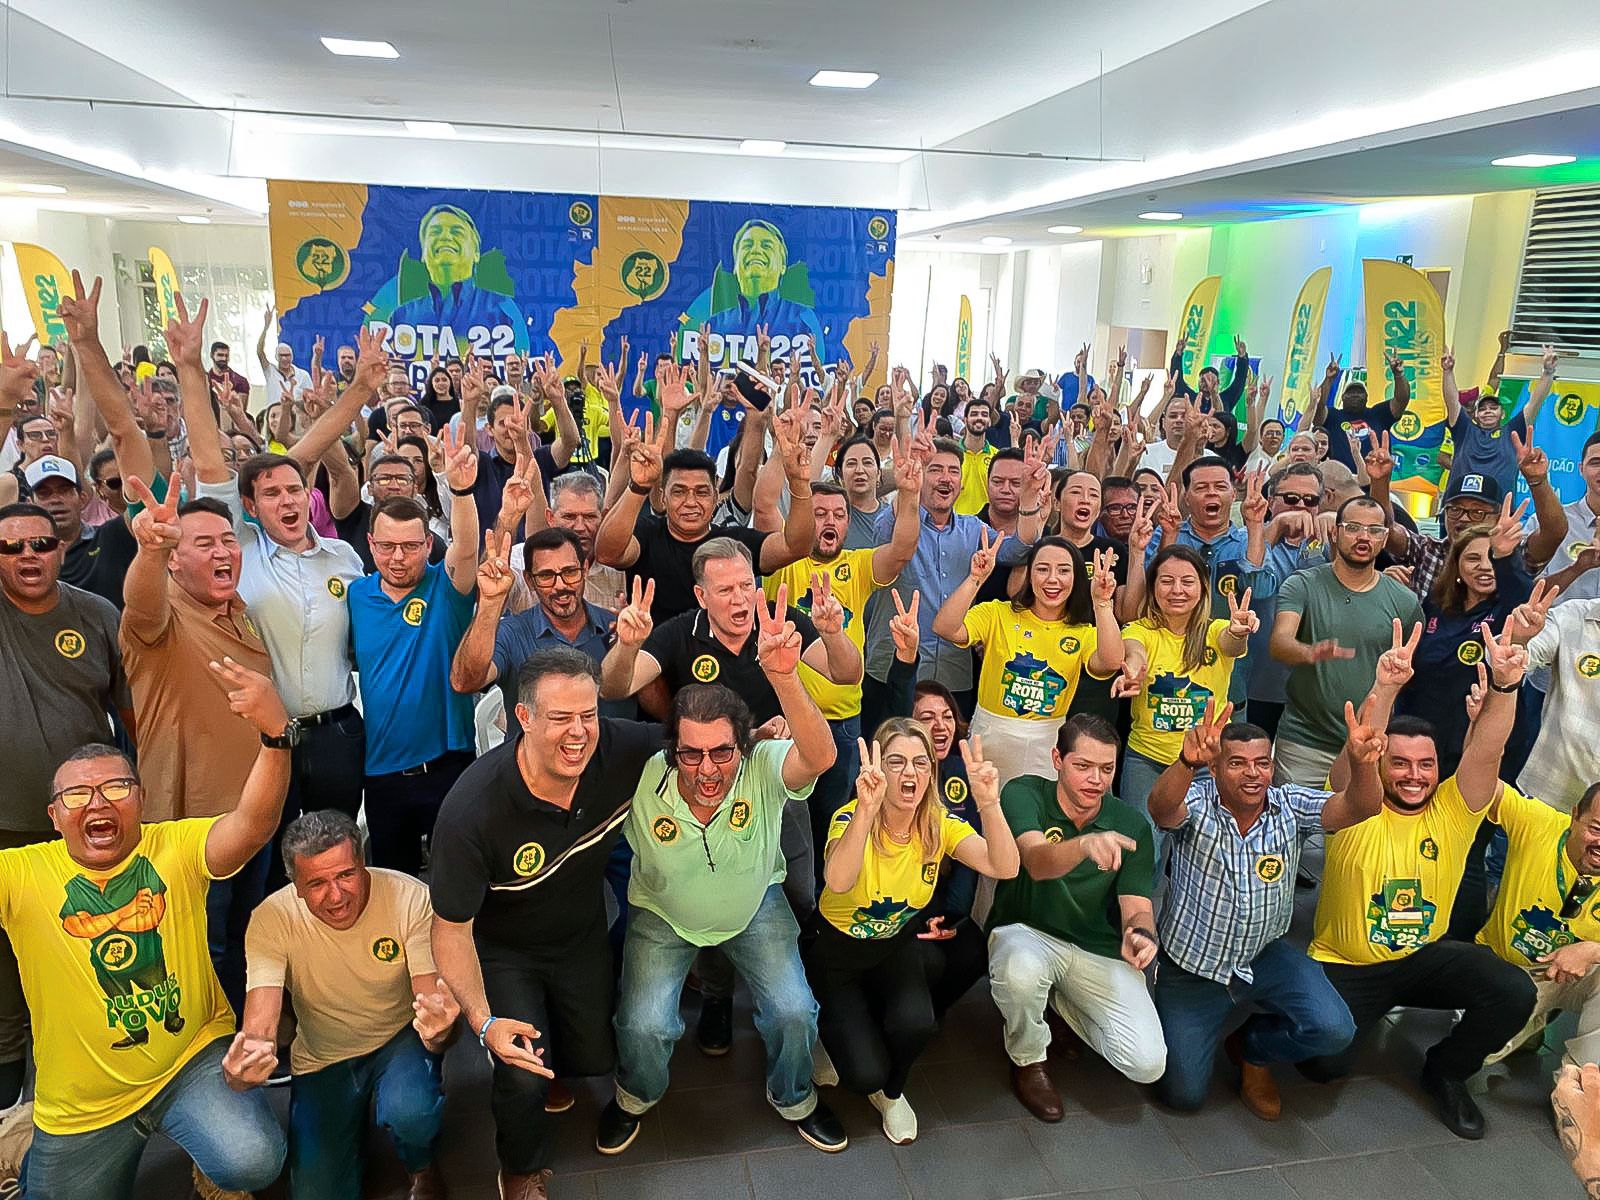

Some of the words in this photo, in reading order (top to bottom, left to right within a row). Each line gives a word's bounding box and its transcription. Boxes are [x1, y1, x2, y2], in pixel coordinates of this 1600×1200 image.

[312, 253, 330, 265] 22
[635, 266, 651, 277] 22
[369, 320, 460, 357] ROTA
[467, 324, 515, 356] 22
[682, 330, 760, 364] ROTA
[771, 334, 811, 362] 22
[1010, 682, 1045, 701] ROTA
[1023, 699, 1042, 712] 22
[1160, 703, 1194, 717] ROTA
[1175, 717, 1193, 729] 22
[734, 809, 744, 818] 22
[660, 824, 671, 833] 22
[1396, 932, 1418, 946] 22
[110, 946, 122, 955] 22
